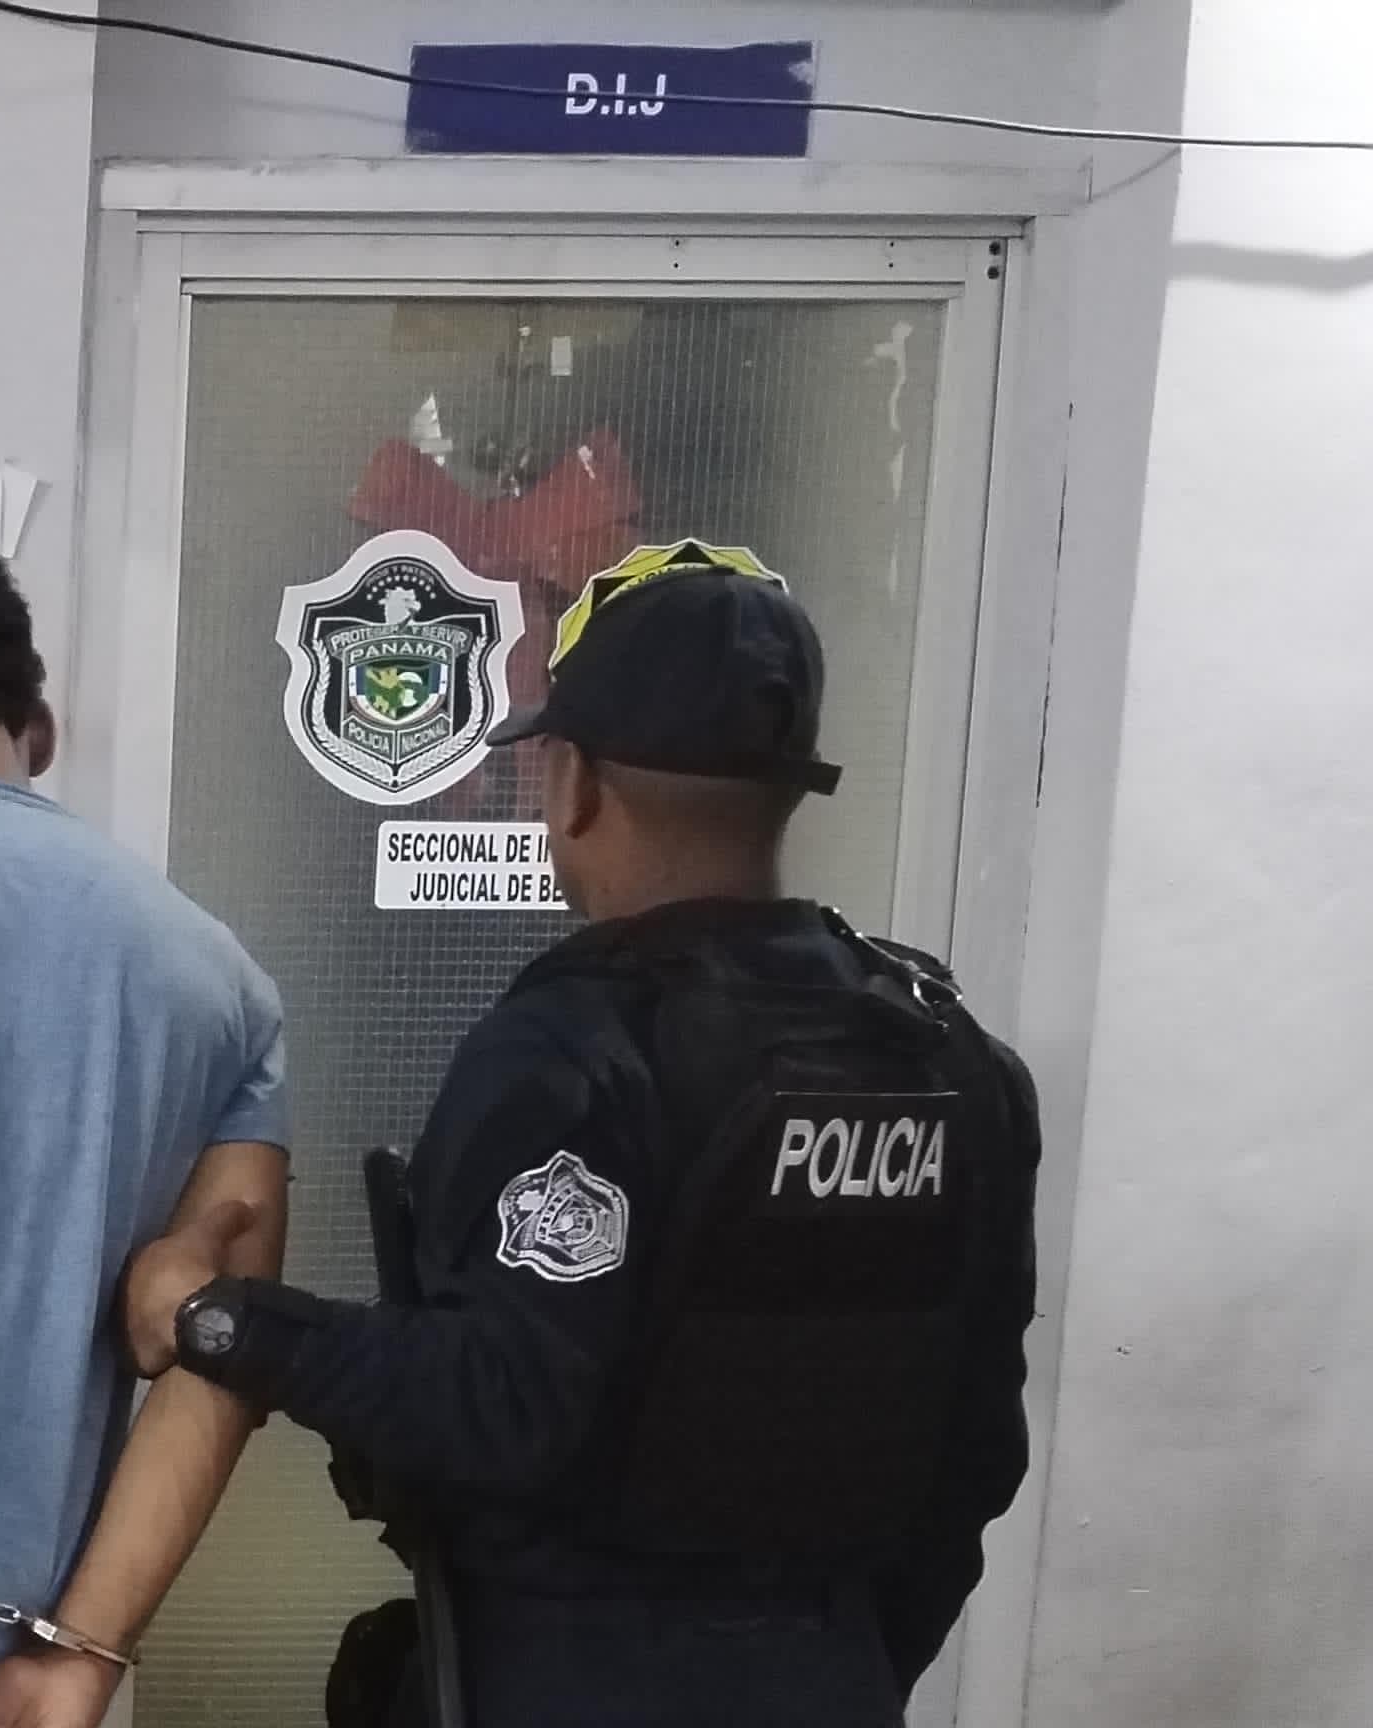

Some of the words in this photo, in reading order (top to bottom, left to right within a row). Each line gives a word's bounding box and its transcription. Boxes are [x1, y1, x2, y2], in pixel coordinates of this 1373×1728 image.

[350, 641, 448, 660] PANAMA
[388, 832, 499, 863] SECCIONAL
[505, 834, 531, 863] DE
[409, 872, 502, 902] JUDICIAL
[507, 874, 533, 902] DE
[770, 1117, 946, 1198] POLICIA
